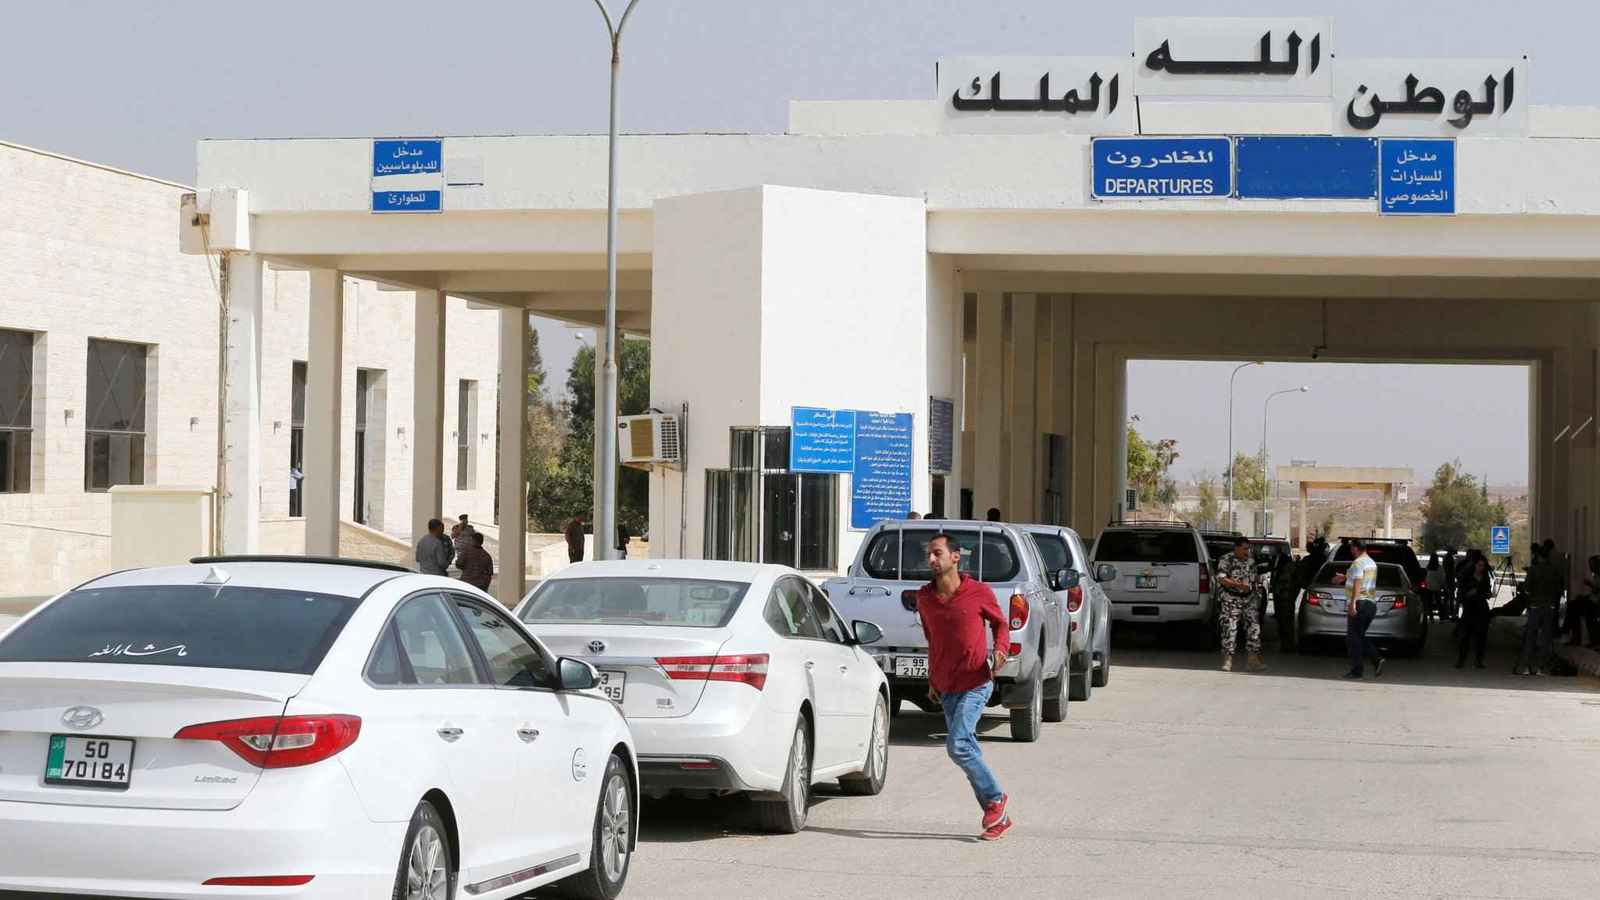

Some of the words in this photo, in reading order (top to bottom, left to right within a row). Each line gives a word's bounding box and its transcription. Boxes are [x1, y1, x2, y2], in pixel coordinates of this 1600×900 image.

[1146, 31, 1320, 76] الله
[952, 71, 1119, 115] الملك
[1347, 68, 1514, 130] الوطن
[393, 145, 423, 159] مدخل
[1106, 150, 1214, 168] المغادرون
[1396, 149, 1437, 165] مدخل
[376, 160, 437, 173] للدبلوماسيين
[1390, 169, 1442, 185] للسيارات
[1105, 178, 1214, 194] DEPARTURES
[1385, 189, 1449, 209] الخصوصي
[912, 658, 924, 667] 99
[598, 673, 610, 685] 3
[85, 741, 109, 758] 50
[64, 760, 126, 781] 70184
[194, 776, 238, 784] Limited
